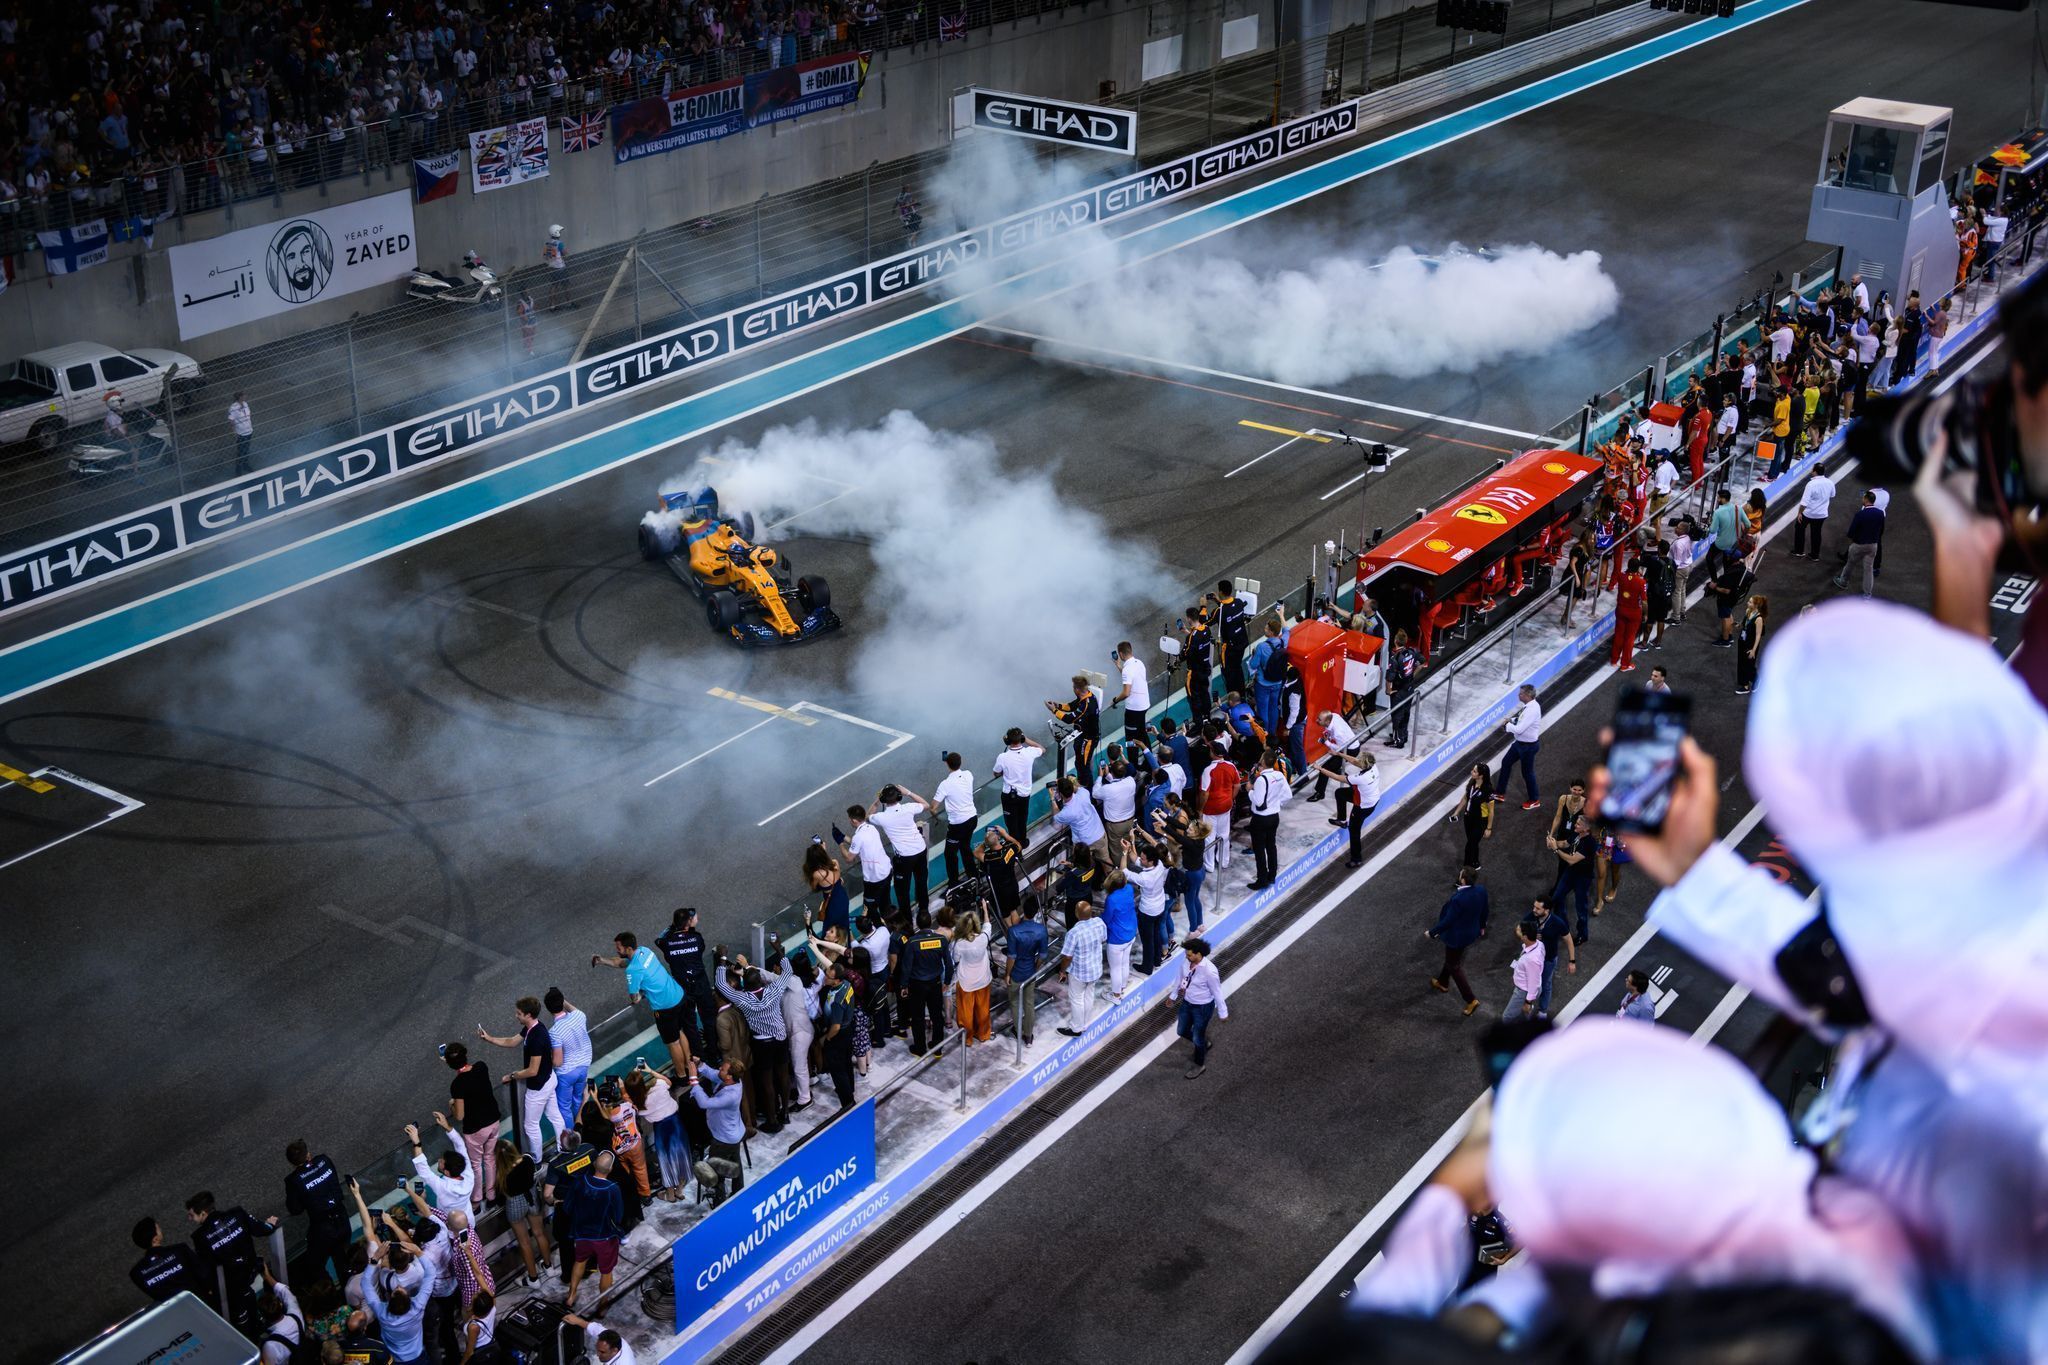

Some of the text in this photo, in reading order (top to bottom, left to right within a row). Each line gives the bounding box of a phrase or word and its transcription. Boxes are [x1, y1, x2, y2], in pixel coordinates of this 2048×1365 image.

[673, 87, 741, 121] #GOMAX
[985, 101, 1118, 143] ETIHAD
[646, 135, 687, 153] VERSTAPPEN
[687, 128, 709, 141] LATEST
[709, 123, 728, 136] NEWS
[1286, 109, 1355, 149] ETIHAD
[1200, 136, 1274, 179] ETIHAD
[1106, 168, 1187, 212] ETIHAD
[344, 224, 384, 242] YEAR OF
[1000, 200, 1091, 248] ETIHAD
[346, 234, 411, 266] ZAYED
[880, 238, 981, 292] ETIHAD
[182, 271, 255, 307] زايد
[743, 281, 859, 339] ETIHAD
[587, 329, 719, 393] ETIHAD
[408, 384, 561, 457] ETIHAD
[198, 448, 377, 530] ETIHAD
[0, 522, 160, 602] TIHAD
[760, 581, 774, 589] 14
[1437, 702, 1506, 763] TATA COMMUNICATIONS
[1254, 833, 1341, 910] TATA COMMUNICATIONS
[669, 946, 699, 956] PETRONAS
[1032, 992, 1142, 1086] TATA COMMUNICATIONS
[305, 1168, 333, 1190] PETRONAS
[752, 1175, 804, 1223] TATA
[211, 1226, 243, 1251] PETRONAS
[696, 1156, 857, 1291] COMMUNICATIONS
[745, 1191, 890, 1313] TATA COMMUNICATIONS
[146, 1263, 183, 1286] PETRONAS
